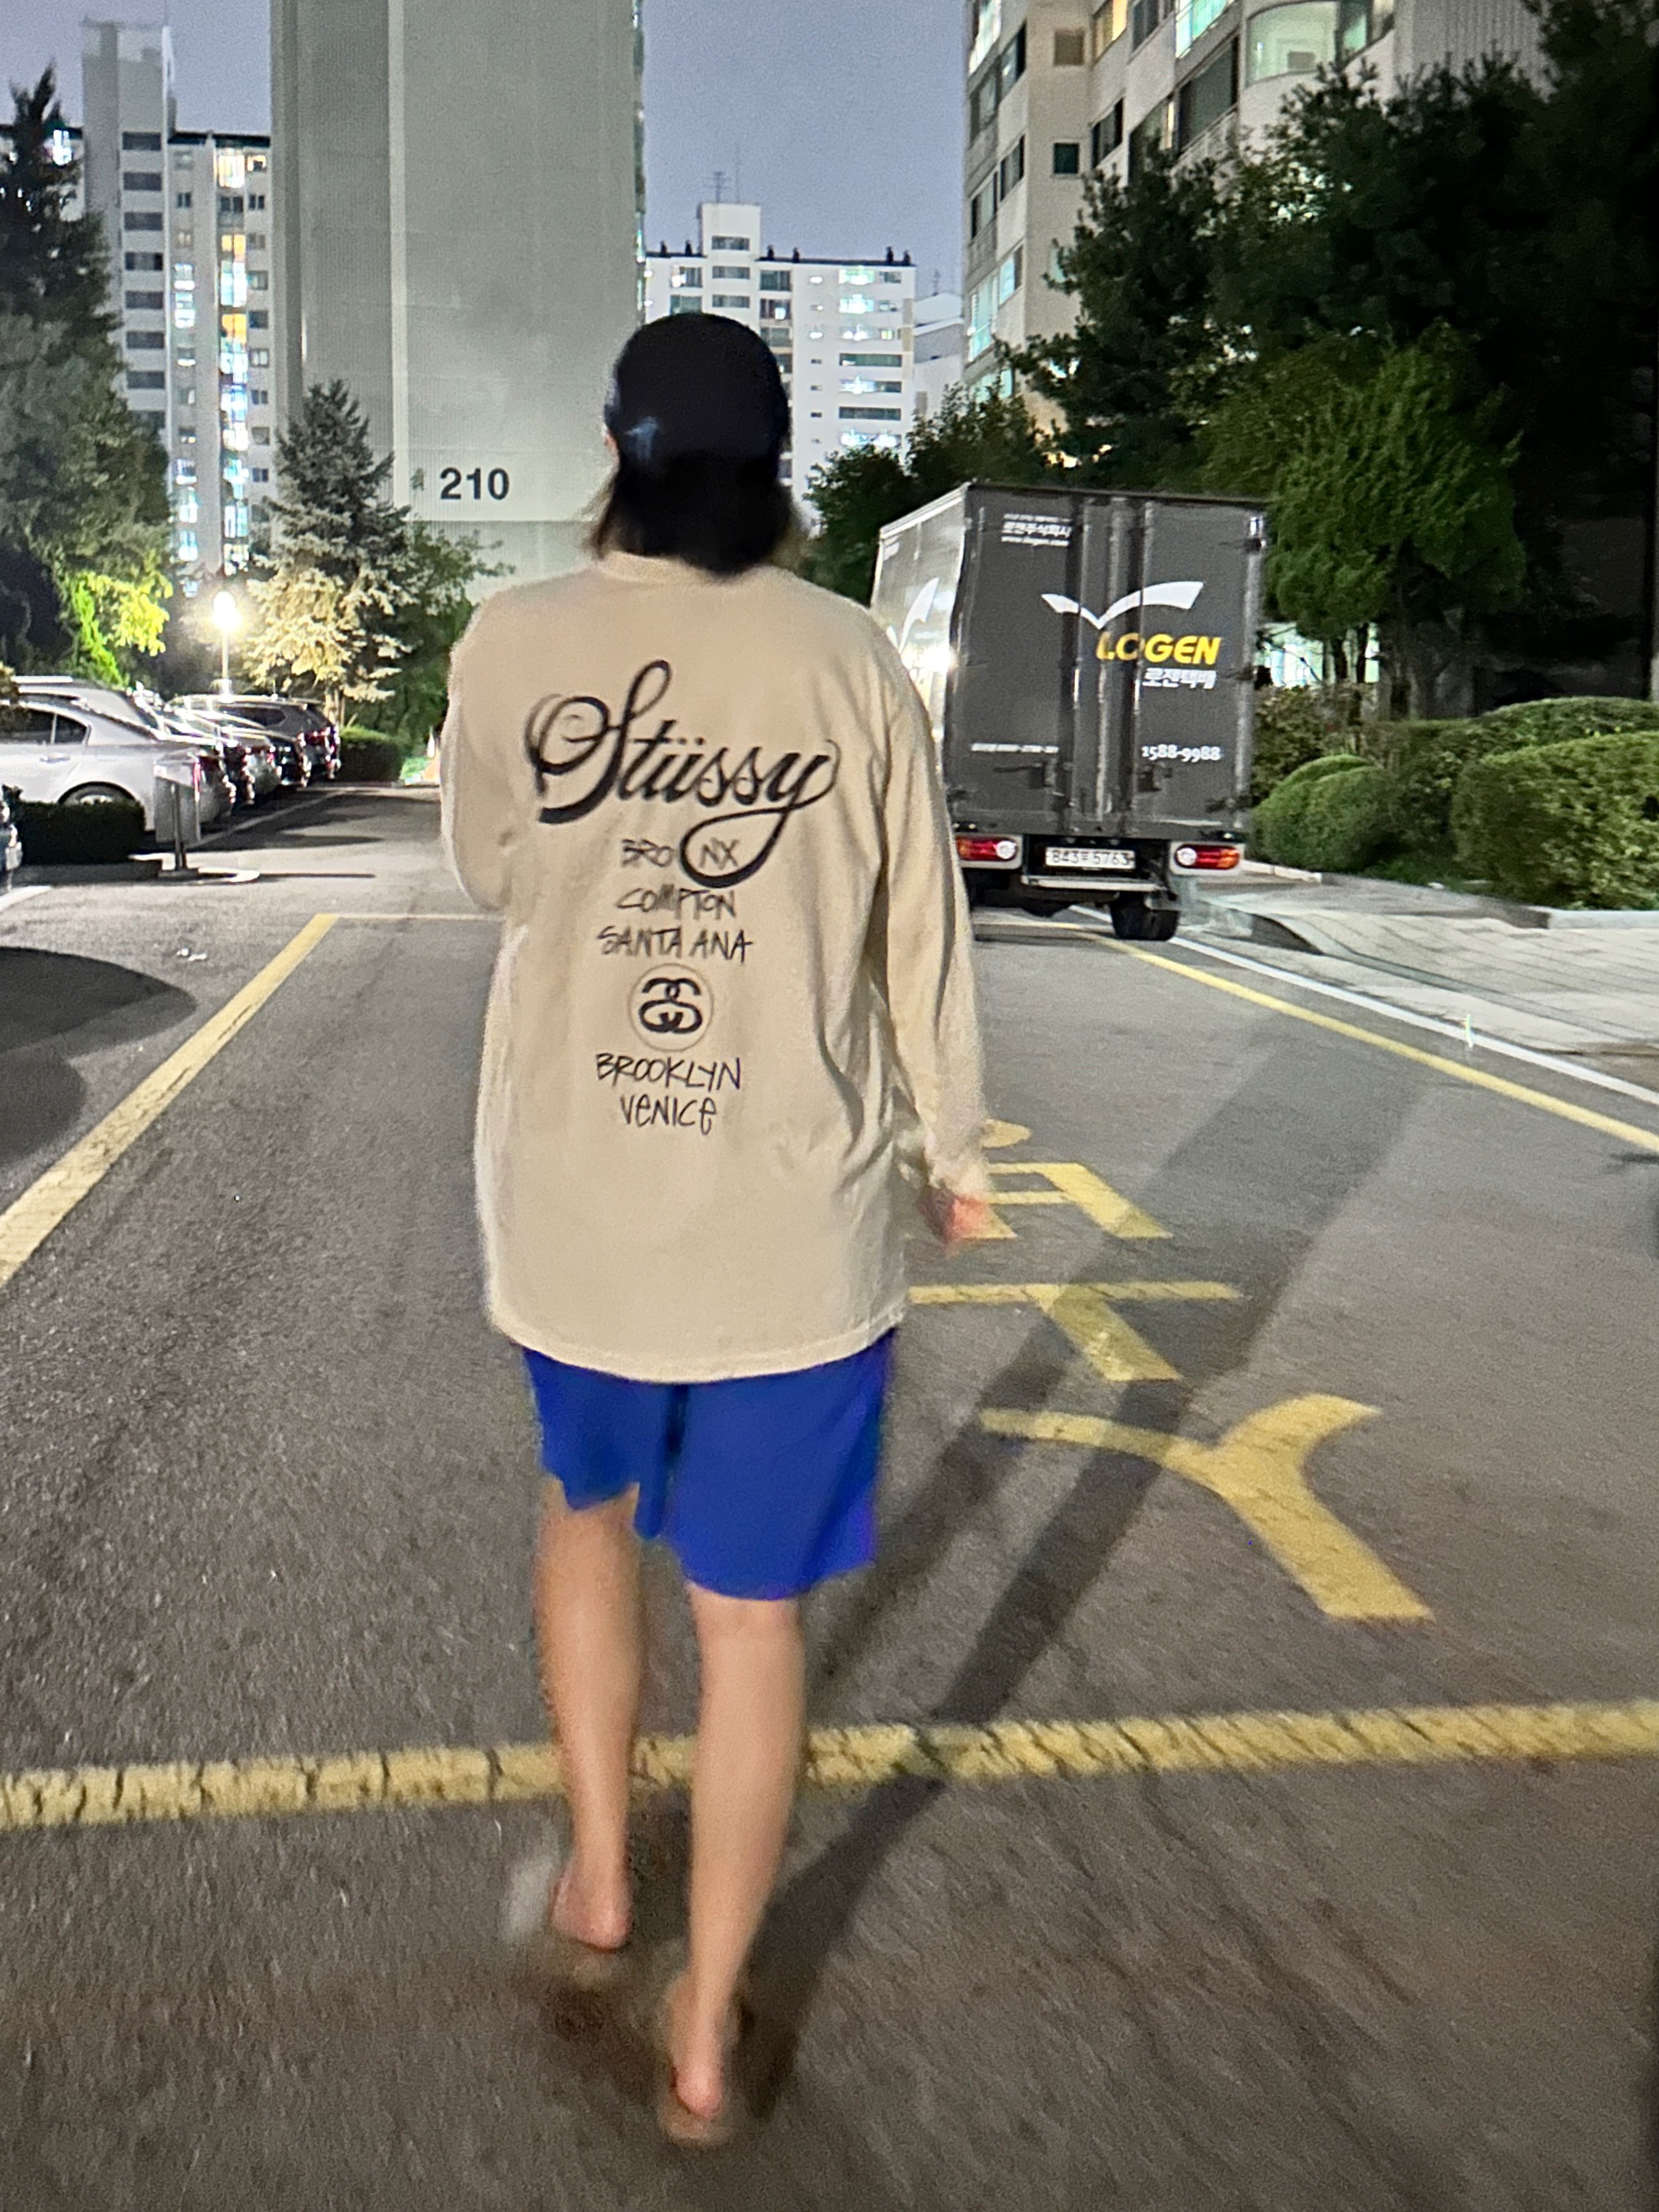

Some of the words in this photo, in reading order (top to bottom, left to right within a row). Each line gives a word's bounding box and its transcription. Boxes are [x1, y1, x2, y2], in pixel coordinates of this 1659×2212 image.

[440, 467, 509, 500] 210
[1097, 633, 1221, 664] LOGEN
[1142, 667, 1217, 690] 로젠택배
[1142, 744, 1221, 762] 1588-9988
[598, 925, 682, 959] SANTA
[689, 929, 754, 963] ANA
[595, 1052, 742, 1091] BROOKLYN
